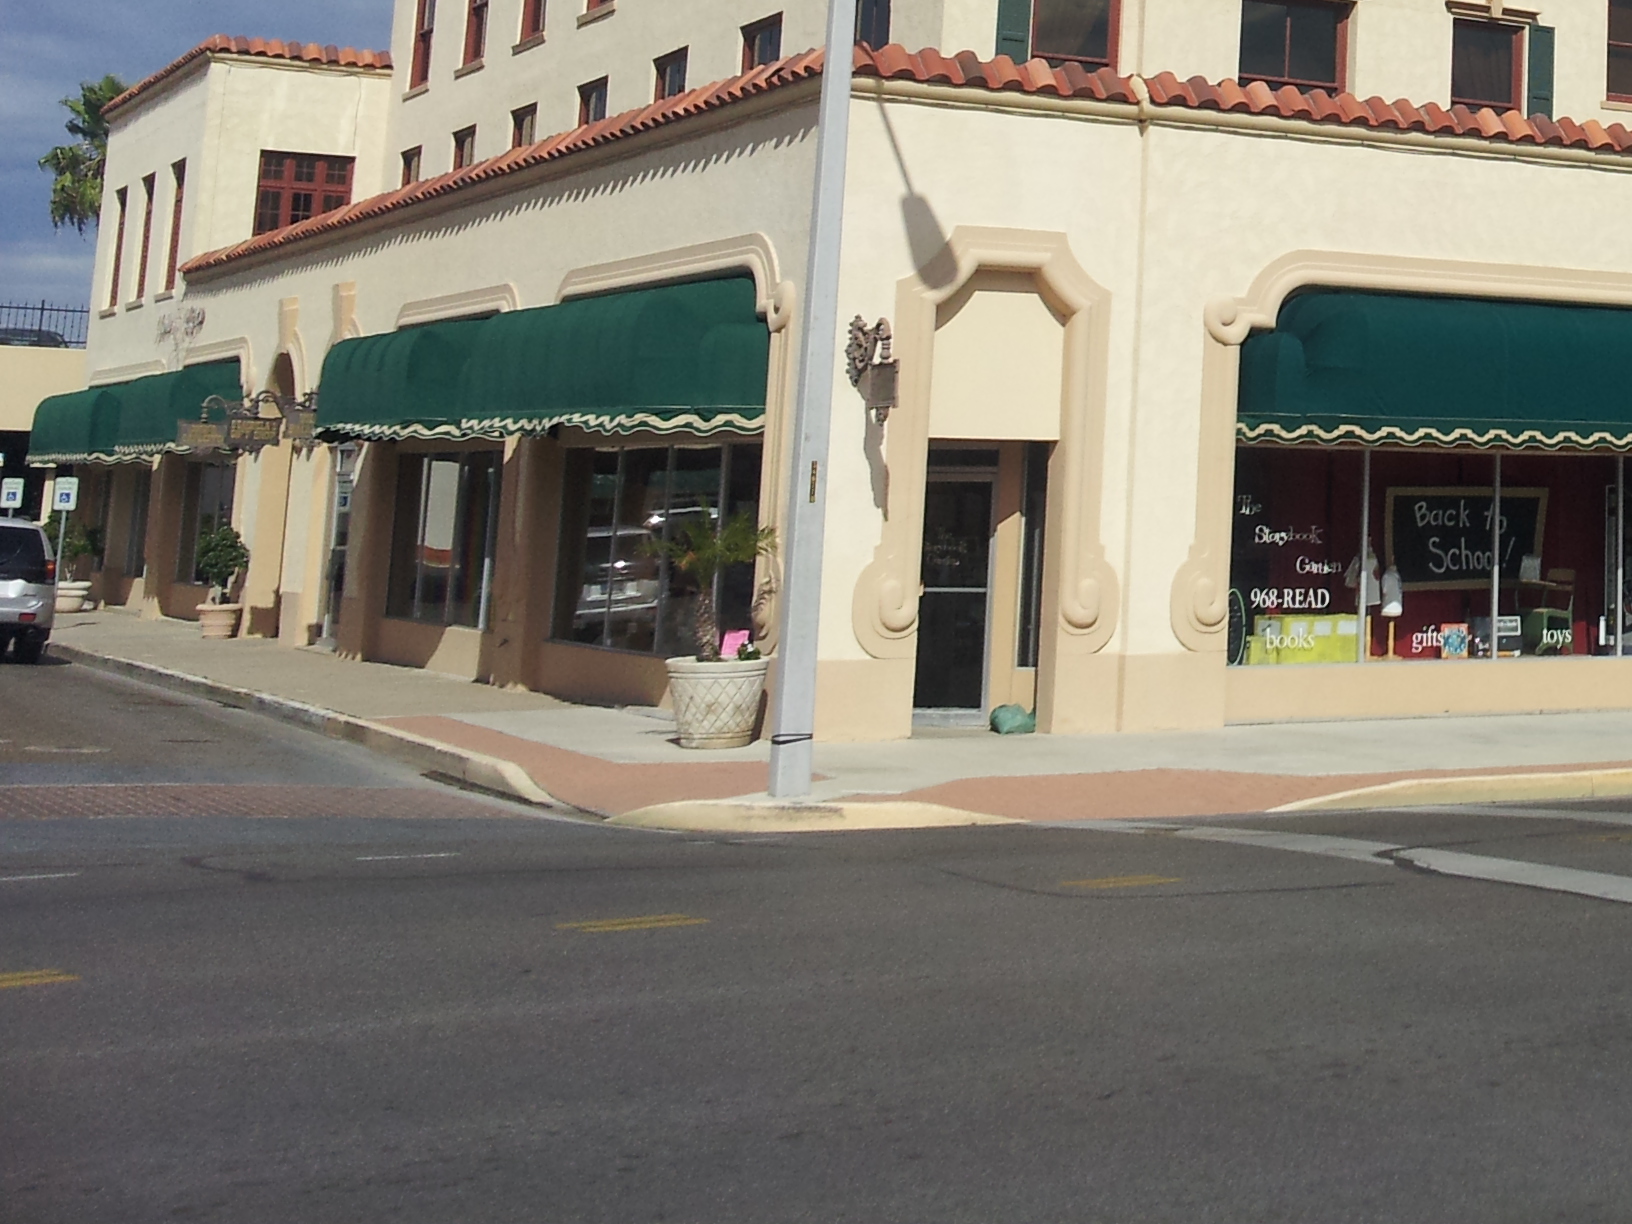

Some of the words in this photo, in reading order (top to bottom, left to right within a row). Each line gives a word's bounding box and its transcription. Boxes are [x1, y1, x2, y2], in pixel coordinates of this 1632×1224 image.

[1414, 499, 1471, 527] Back
[1428, 536, 1515, 573] Schoo!
[1250, 588, 1330, 609] 968-READ
[1266, 627, 1316, 649] books
[1412, 626, 1444, 654] gifts
[1542, 627, 1572, 649] toys
